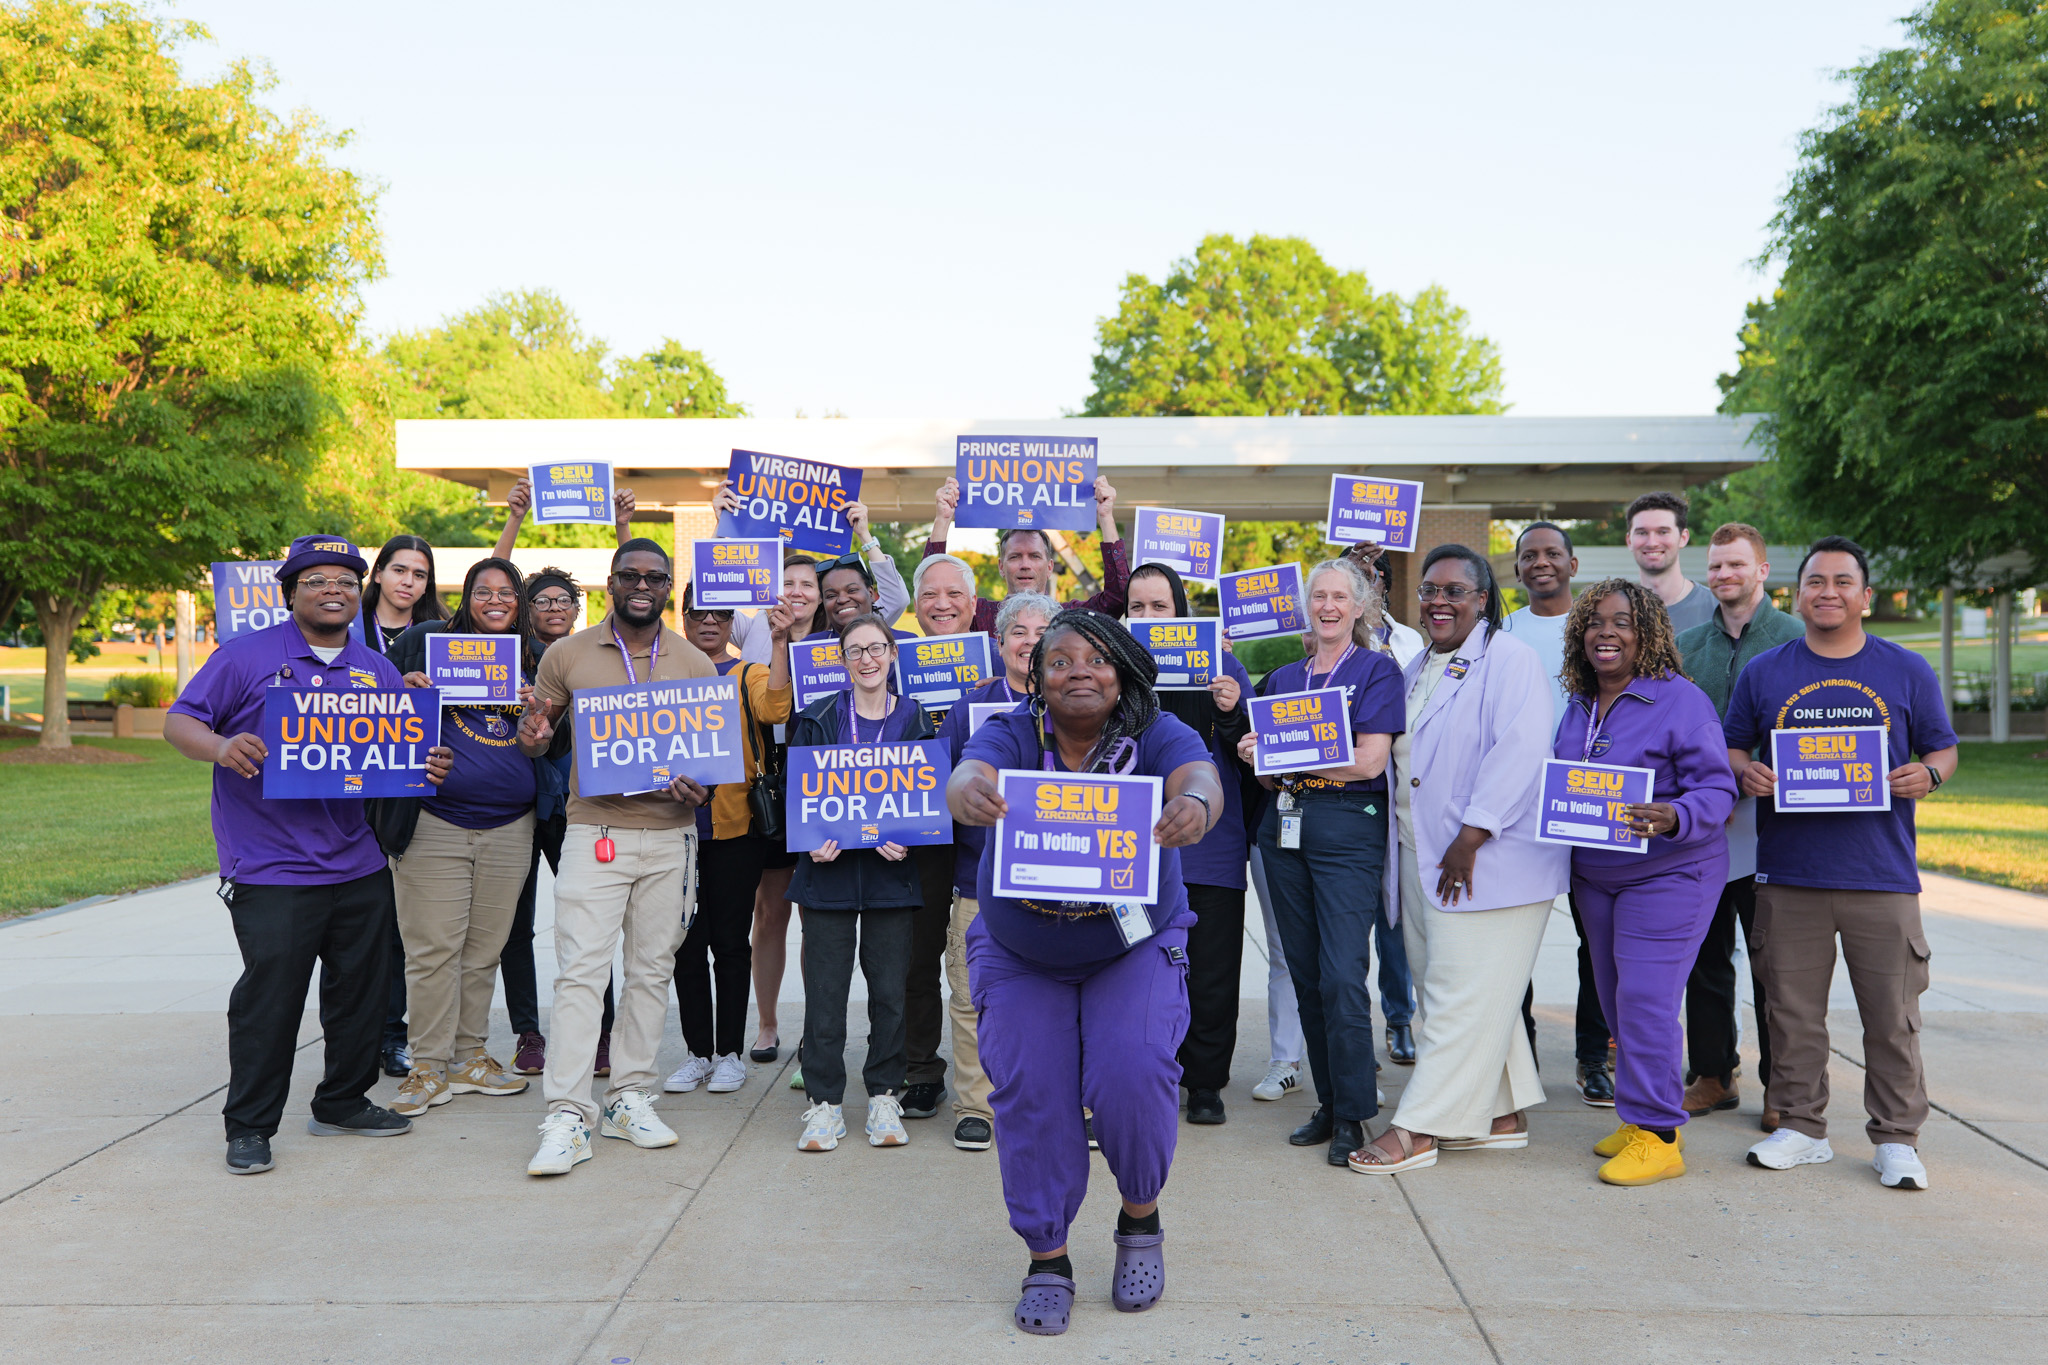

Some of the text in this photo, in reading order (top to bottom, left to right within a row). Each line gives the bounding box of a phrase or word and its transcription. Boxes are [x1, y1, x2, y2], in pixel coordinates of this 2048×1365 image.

[960, 442, 1095, 459] PRINCE WILLIAM
[549, 465, 594, 480] SEIU
[750, 455, 842, 487] VIRGINIA
[968, 459, 1084, 484] UNIONS
[542, 486, 604, 502] I'm Voting YES
[737, 473, 847, 511] UNIONS
[967, 482, 1086, 507] FOR ALL
[1352, 482, 1399, 500] SEIU
[733, 495, 844, 534] FOR ALL
[1156, 514, 1202, 532] SEIU
[1338, 507, 1407, 527] I'm Voting YES
[1156, 528, 1188, 537] VIRGINIA
[713, 545, 759, 560] SEIU
[1144, 539, 1211, 558] I'm Voting YES
[702, 568, 771, 585] I'm Voting YES
[1235, 572, 1279, 593] SEIU
[1237, 589, 1267, 599] VIRGINIA
[1229, 595, 1294, 617] I'm Voting YES
[230, 607, 291, 632] FOR
[1149, 625, 1197, 642] SEIU
[448, 640, 496, 656] SEIU
[916, 641, 965, 661] SEIU
[917, 658, 952, 666] VIRGINIA
[1154, 650, 1210, 668] Voting YES
[437, 664, 508, 681] I'm Voting YES
[803, 672, 846, 685] I'm Voting
[908, 665, 980, 685] I'm Voting YES
[293, 692, 416, 714] VIRGINIA
[577, 684, 735, 714] PRINCE WILLIAM
[1786, 693, 1800, 706] 512
[1799, 682, 1821, 696] SEIU
[1821, 679, 1862, 690] VIRGINIA
[1862, 686, 1877, 698] 512
[1873, 696, 1890, 717] SEIU
[1271, 697, 1322, 719] SEIU
[1793, 707, 1873, 719] ONE UNION
[281, 716, 424, 743] UNIONS
[589, 704, 726, 741] UNIONS
[1273, 715, 1309, 725] VIRGINIA
[1264, 722, 1338, 745] I'm Voting YES
[591, 731, 731, 768] FOR ALL
[1798, 735, 1857, 754] SEIU
[280, 744, 426, 770] FOR ALL
[812, 745, 928, 769] VIRGINIA
[653, 775, 670, 783] SEIU
[802, 766, 937, 796] UNIONS
[1567, 769, 1625, 791] SEIU
[1786, 762, 1873, 783] I'm Voting YES
[1035, 784, 1119, 813] SEIU
[1566, 786, 1623, 798] VIRGINIA 512
[801, 791, 940, 823] FOR ALL
[1035, 810, 1118, 822] VIRGINIA 512
[1551, 799, 1567, 812] I'm
[1570, 800, 1603, 817] Voting
[1014, 829, 1138, 859] I'm Voting YES
[469, 1067, 487, 1080] N
[423, 1080, 438, 1094] N
[618, 1113, 631, 1127] N
[571, 1135, 583, 1149] N
